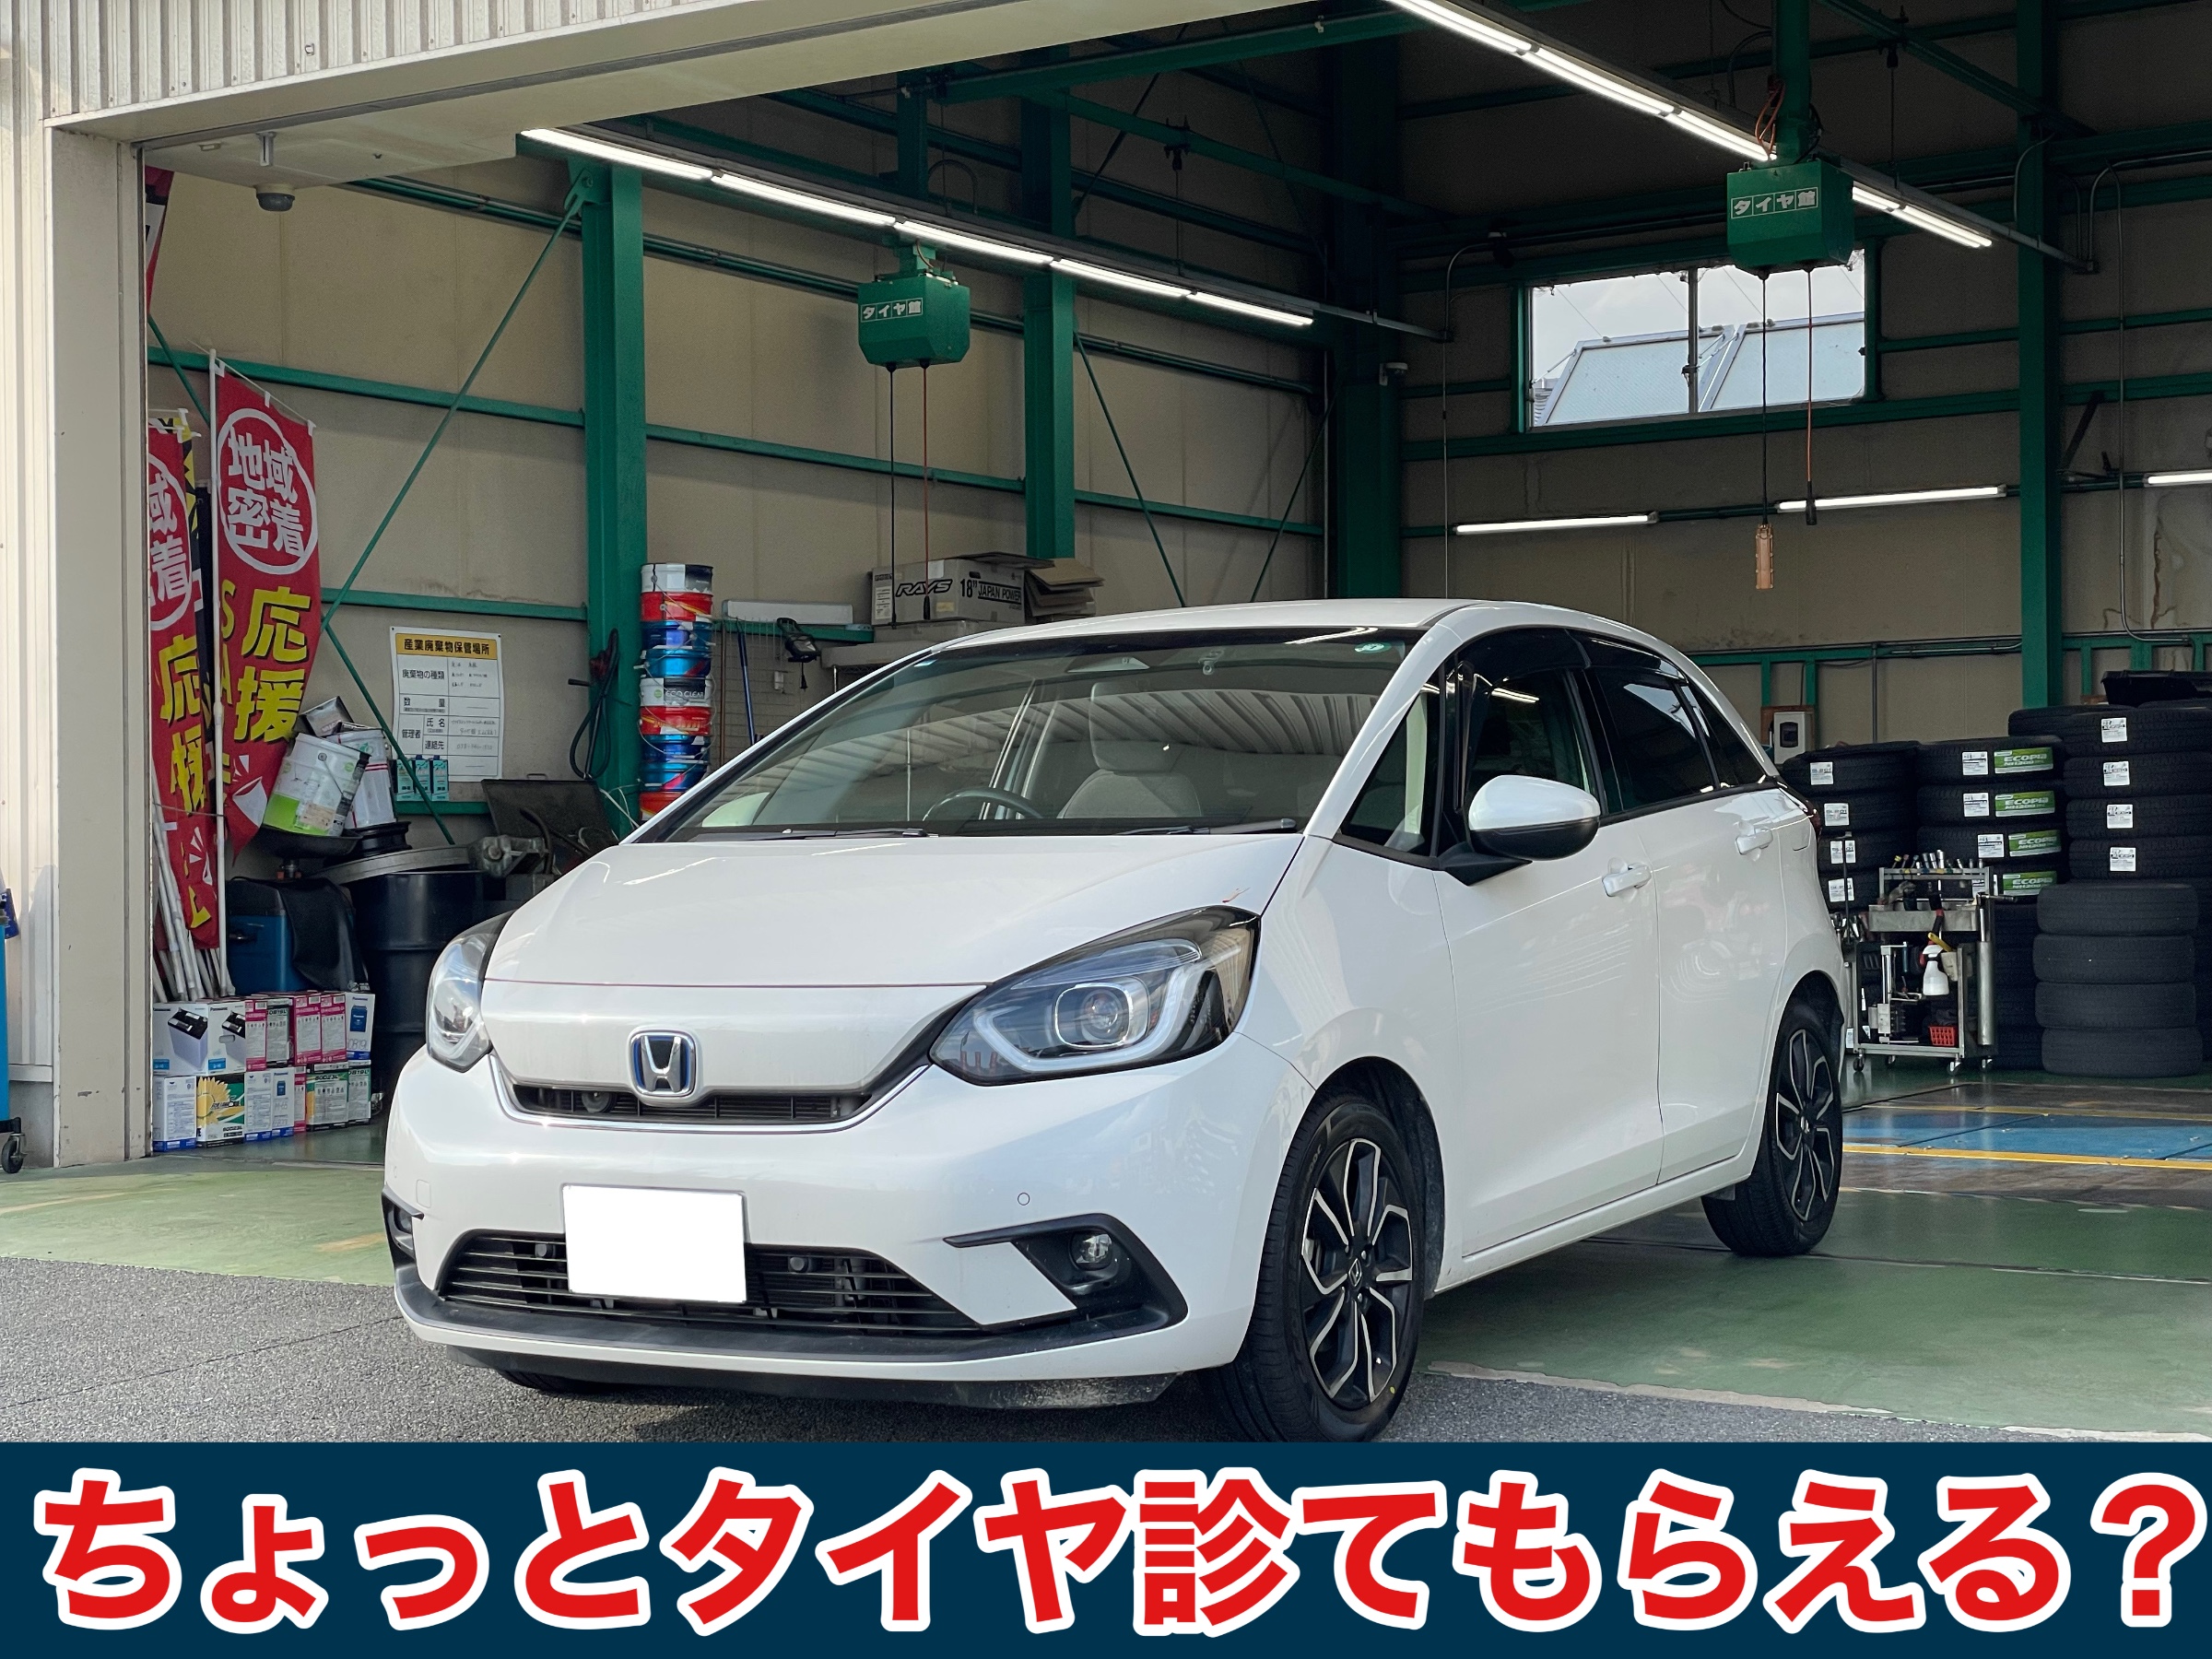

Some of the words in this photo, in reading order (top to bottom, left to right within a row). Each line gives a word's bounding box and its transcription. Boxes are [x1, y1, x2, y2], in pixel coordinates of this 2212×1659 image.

[227, 431, 299, 502] 地域
[227, 488, 305, 558] 密着
[896, 578, 953, 598] RAYS
[978, 586, 1000, 598] JAPAN
[1002, 588, 1022, 602] POWER
[233, 586, 312, 743] 応援
[404, 638, 490, 655] 産業廃棄物保管場所
